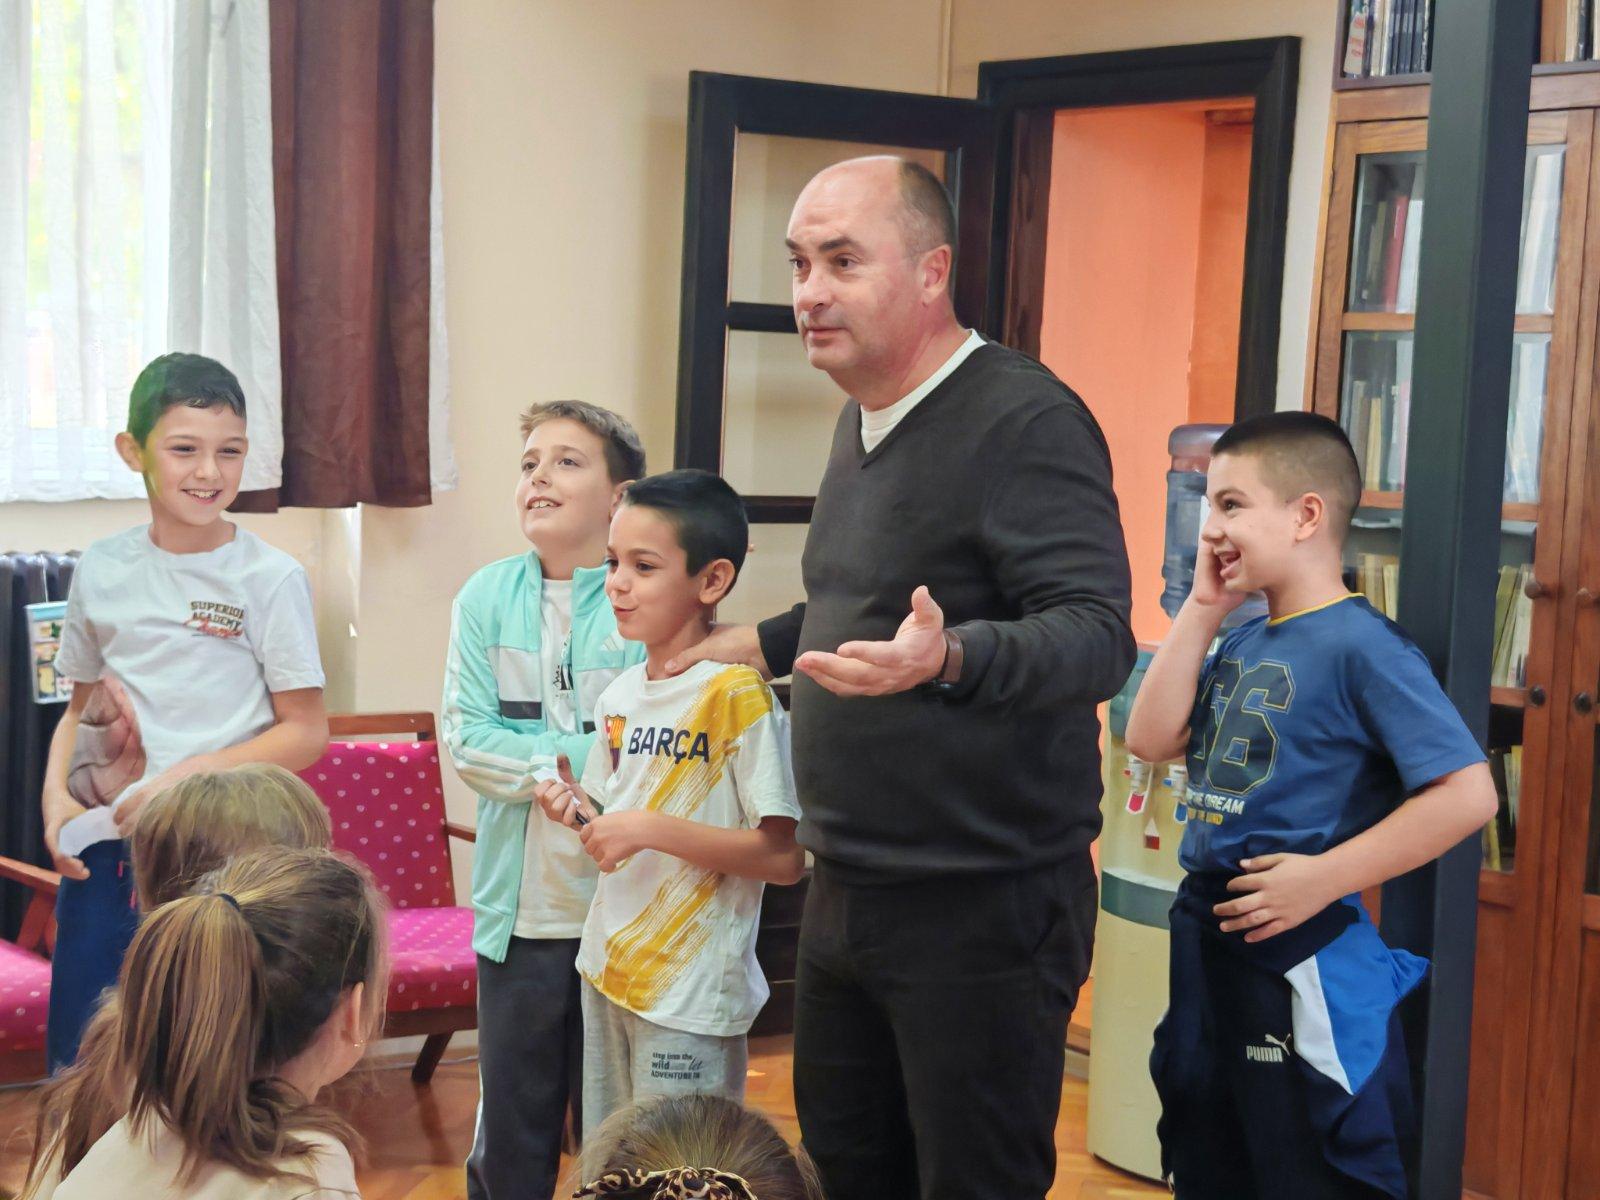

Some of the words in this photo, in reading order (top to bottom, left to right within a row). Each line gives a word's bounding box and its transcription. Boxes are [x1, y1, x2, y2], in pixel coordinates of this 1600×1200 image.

[627, 726, 710, 765] BARÇA
[1204, 793, 1245, 815] DREAM
[682, 1052, 693, 1060] the
[1246, 1045, 1283, 1062] PUMA
[651, 1060, 670, 1070] wild
[651, 1070, 692, 1080] ADVENTURE
